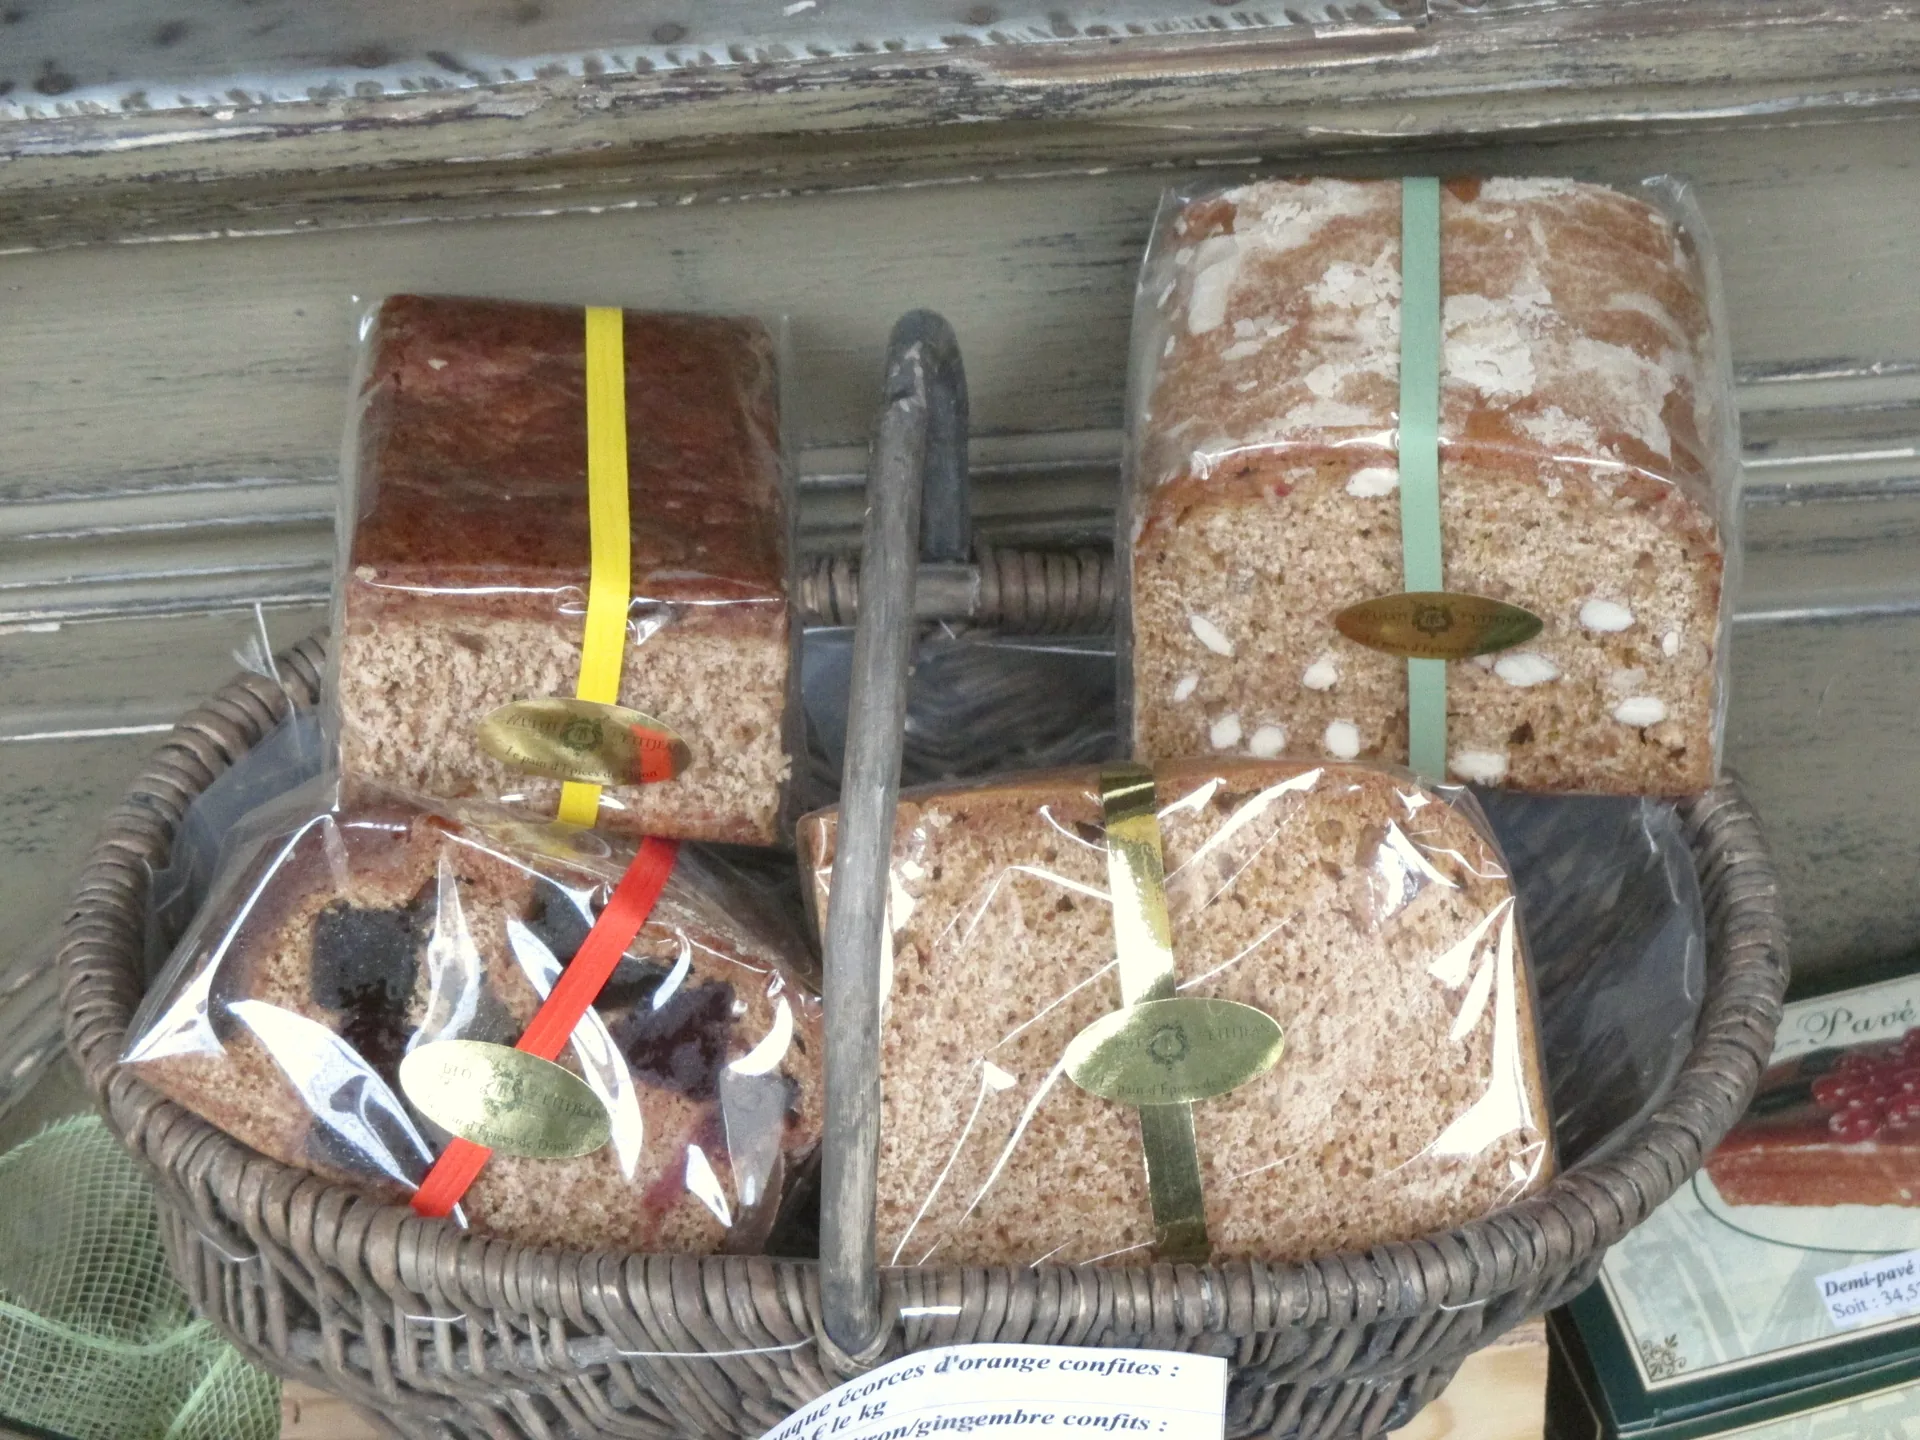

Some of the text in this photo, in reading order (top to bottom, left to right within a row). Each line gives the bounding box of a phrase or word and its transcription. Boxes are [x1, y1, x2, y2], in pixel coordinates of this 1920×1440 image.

[1796, 998, 1917, 1045] Pavé
[1824, 1259, 1915, 1298] Demi-pavé
[1831, 1298, 1869, 1319] Soit
[837, 1364, 926, 1408] écorces
[934, 1354, 1051, 1374] d'orange
[1058, 1357, 1162, 1377] confites
[831, 1415, 852, 1434] le
[858, 1400, 888, 1421] kg
[1063, 1412, 1151, 1432] confits
